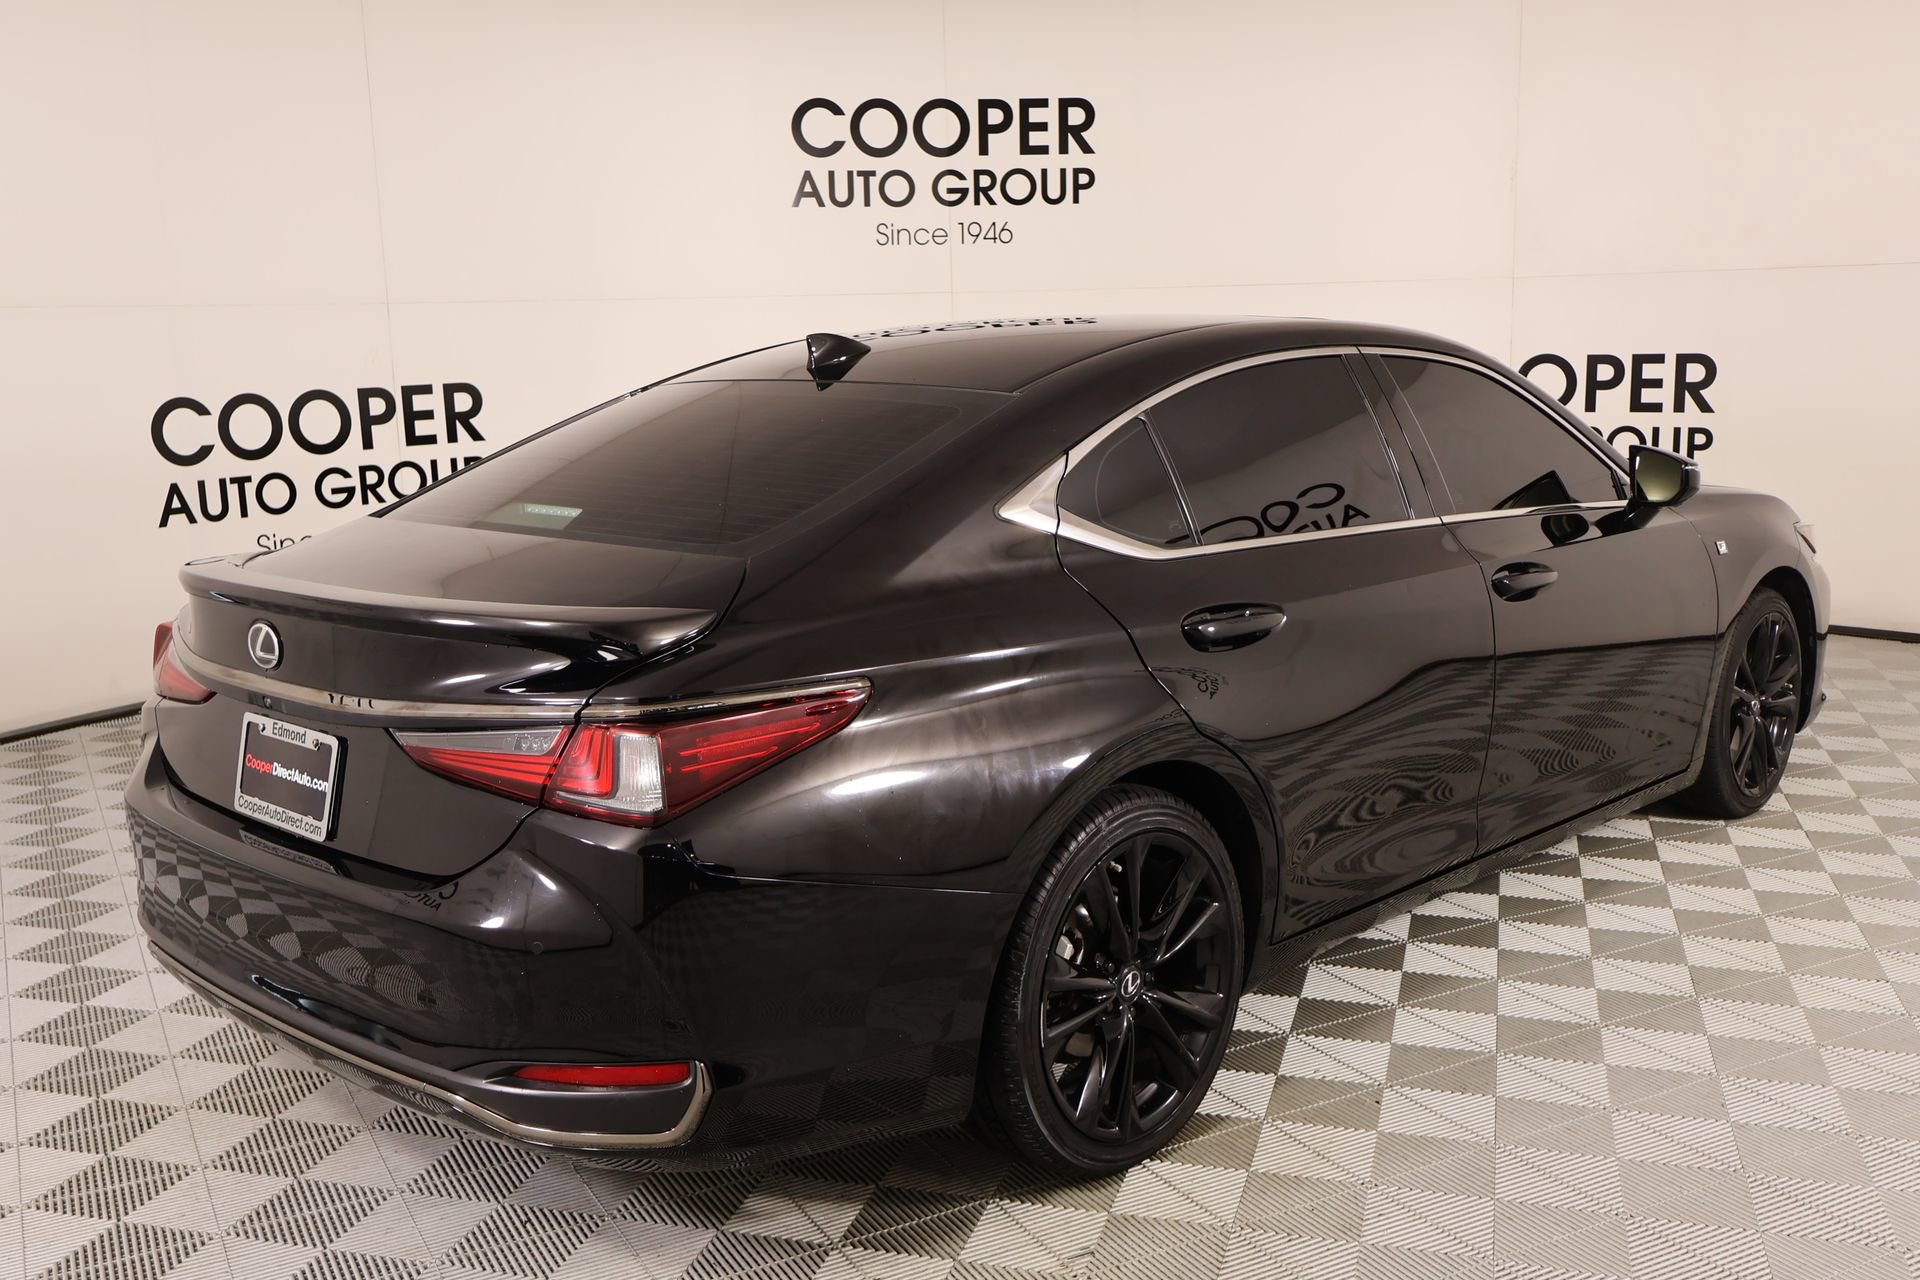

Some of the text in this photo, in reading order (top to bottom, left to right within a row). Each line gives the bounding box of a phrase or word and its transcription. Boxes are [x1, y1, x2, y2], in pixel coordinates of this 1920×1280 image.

[791, 97, 1096, 158] COOPER
[791, 167, 1096, 208] AUTO GROUP
[876, 221, 1014, 246] Since 1946
[1518, 353, 1718, 413] OPER
[150, 382, 486, 467] COOPER
[158, 472, 297, 529] AUTO
[271, 721, 307, 744] Edmond
[238, 795, 322, 838] CooperAutoDirect.com
